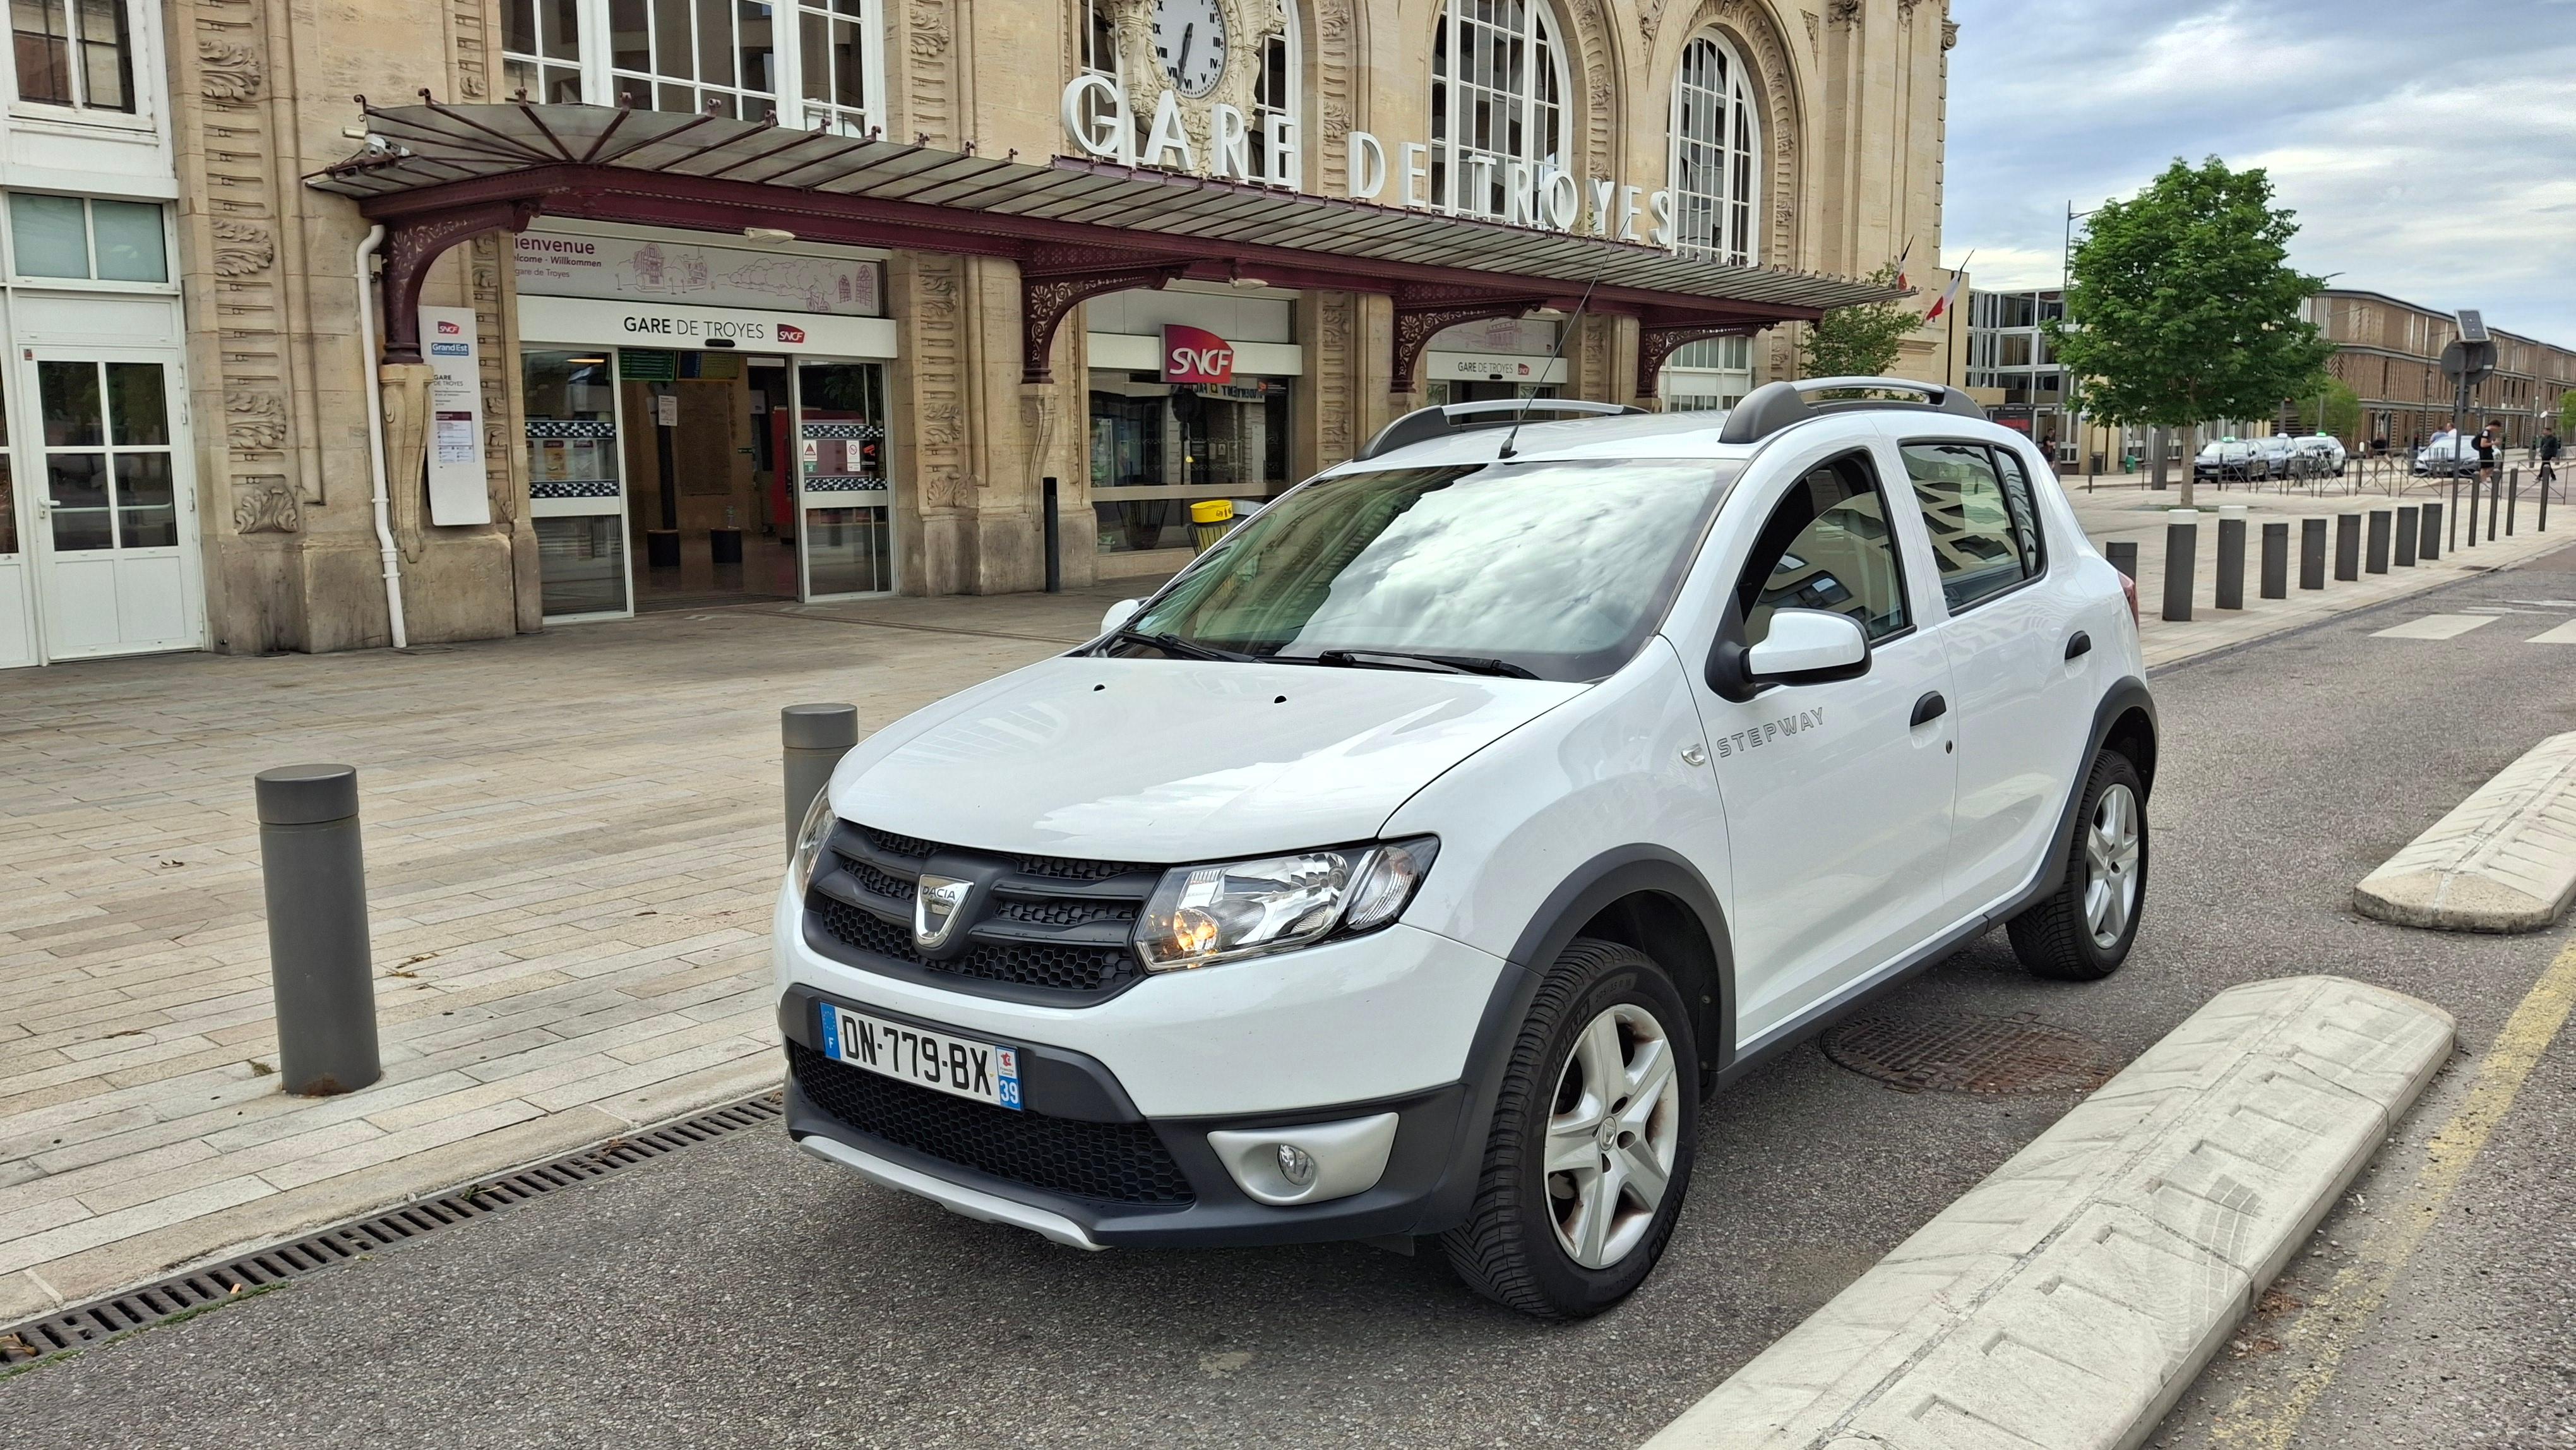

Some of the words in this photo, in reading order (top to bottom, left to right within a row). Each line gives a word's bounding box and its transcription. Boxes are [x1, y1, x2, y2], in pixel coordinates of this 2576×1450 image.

[1210, 13, 1215, 24] II
[1152, 23, 1162, 35] IX
[1155, 45, 1167, 58] VIII
[1210, 58, 1218, 69] IV
[1167, 66, 1178, 78] VII
[1200, 73, 1207, 83] V
[1184, 78, 1192, 90] VI
[1061, 75, 1297, 188] GARE
[1348, 131, 1427, 208] DE
[1468, 155, 1671, 246] TROYES
[514, 233, 595, 255] ienvenue
[514, 253, 542, 263] lcome
[551, 256, 602, 267] Willkommen
[534, 268, 544, 276] de
[546, 268, 569, 279] Troyes
[624, 316, 671, 334] GARE
[677, 319, 699, 335] DE
[703, 321, 764, 339] TROYES
[778, 330, 804, 341] SNCF
[1169, 347, 1232, 376] SNCF
[1458, 362, 1477, 372] GARE
[1478, 362, 1488, 373] DE
[1489, 362, 1513, 374] TROYES
[1717, 707, 1823, 758] STEPWAY
[922, 886, 956, 901] DACIA
[828, 1036, 834, 1049] F
[842, 1014, 992, 1096] DN-779-BX
[999, 1079, 1019, 1105] 39
